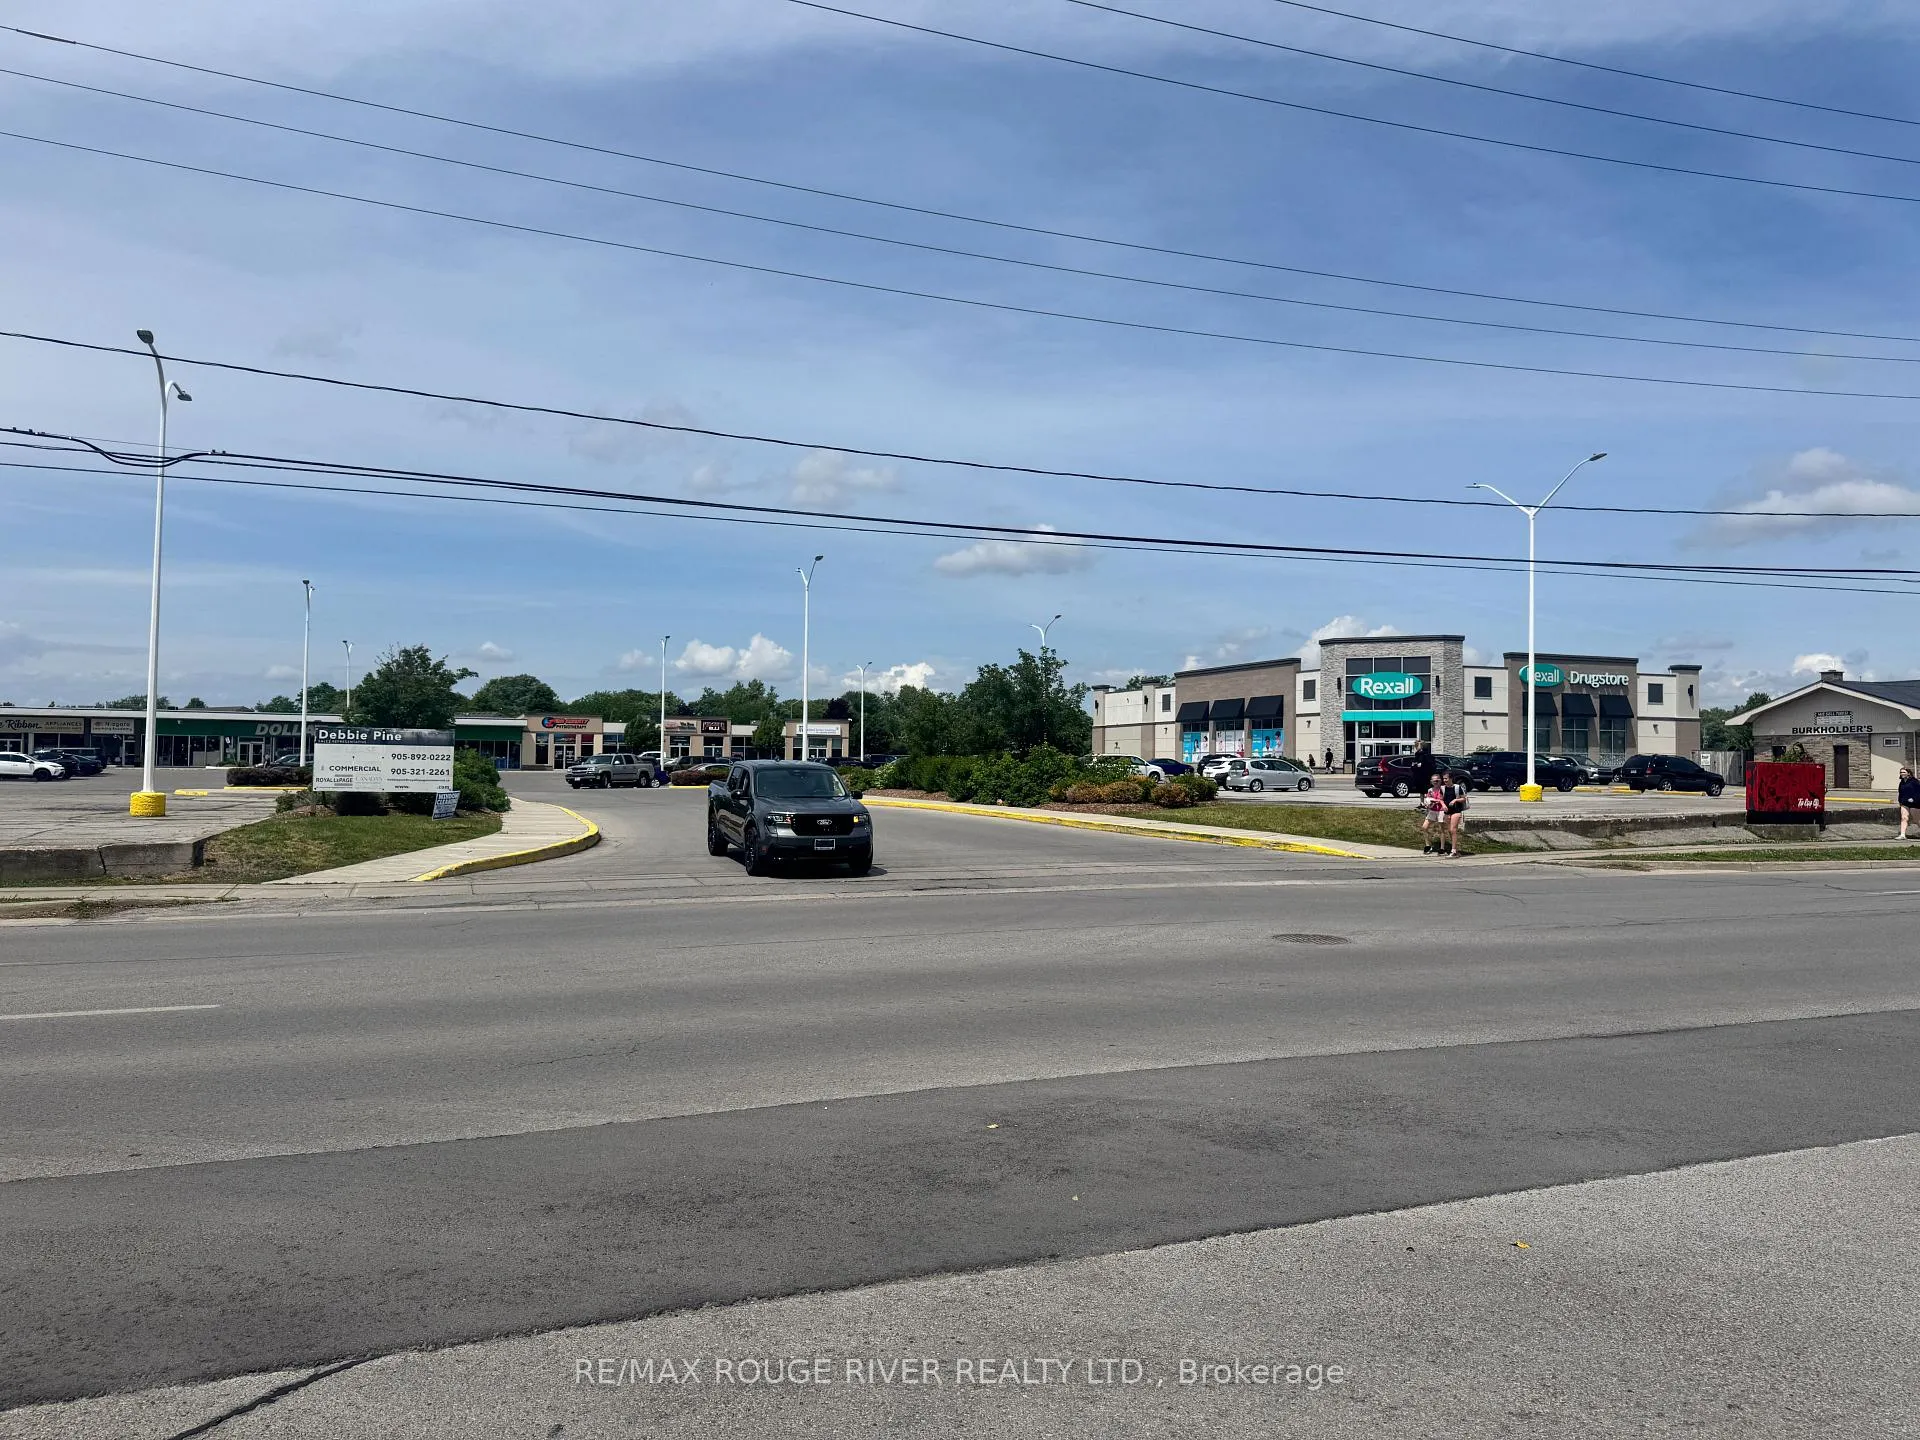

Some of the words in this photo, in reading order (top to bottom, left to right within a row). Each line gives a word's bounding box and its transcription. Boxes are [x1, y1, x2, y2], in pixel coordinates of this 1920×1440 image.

[1526, 667, 1560, 683] exall
[1569, 671, 1629, 688] Drugstore
[1360, 677, 1414, 696] Rexall
[5, 719, 42, 730] Ribbon
[1792, 725, 1873, 734] BURKHOLDER'S
[318, 729, 368, 741] Debbie
[373, 731, 402, 741] Pine
[391, 753, 451, 761] 905-892-0222
[390, 768, 450, 776] 905-321-2261
